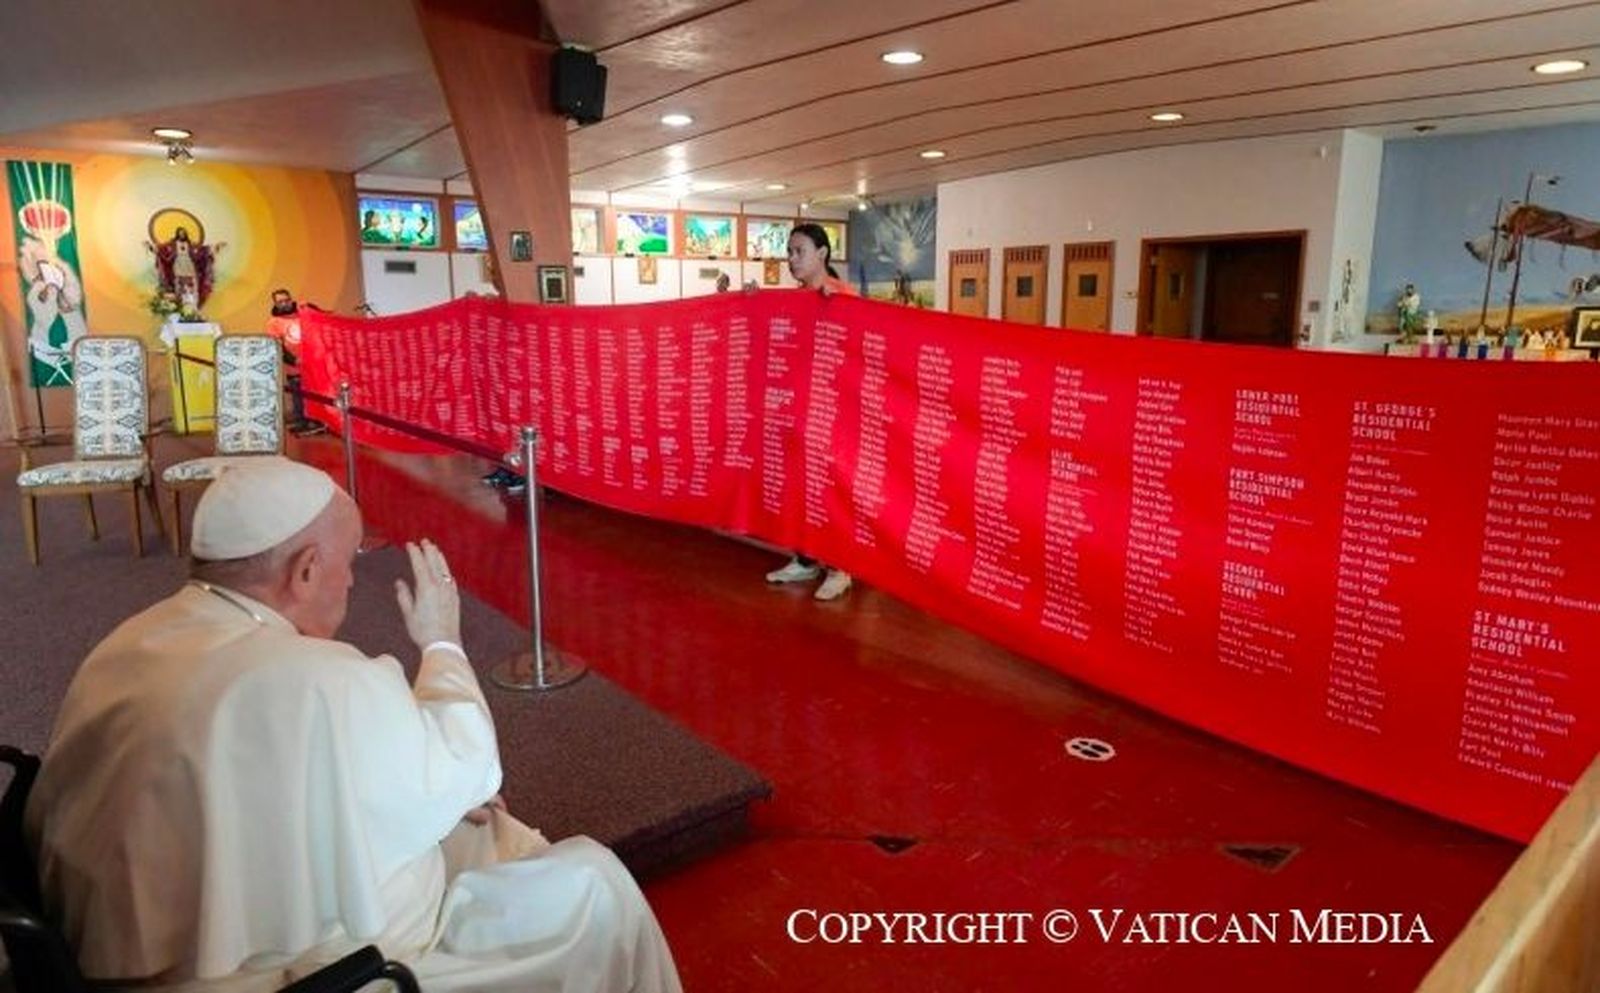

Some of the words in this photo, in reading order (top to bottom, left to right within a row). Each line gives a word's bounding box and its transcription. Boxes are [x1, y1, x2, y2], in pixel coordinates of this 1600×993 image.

[1354, 413, 1431, 432] RESIDENTIAL
[1352, 426, 1397, 441] SCHOOL
[1497, 614, 1550, 635] MARY'S
[1472, 636, 1522, 658] SCHOOL
[1474, 623, 1567, 653] RESIDENTIAL
